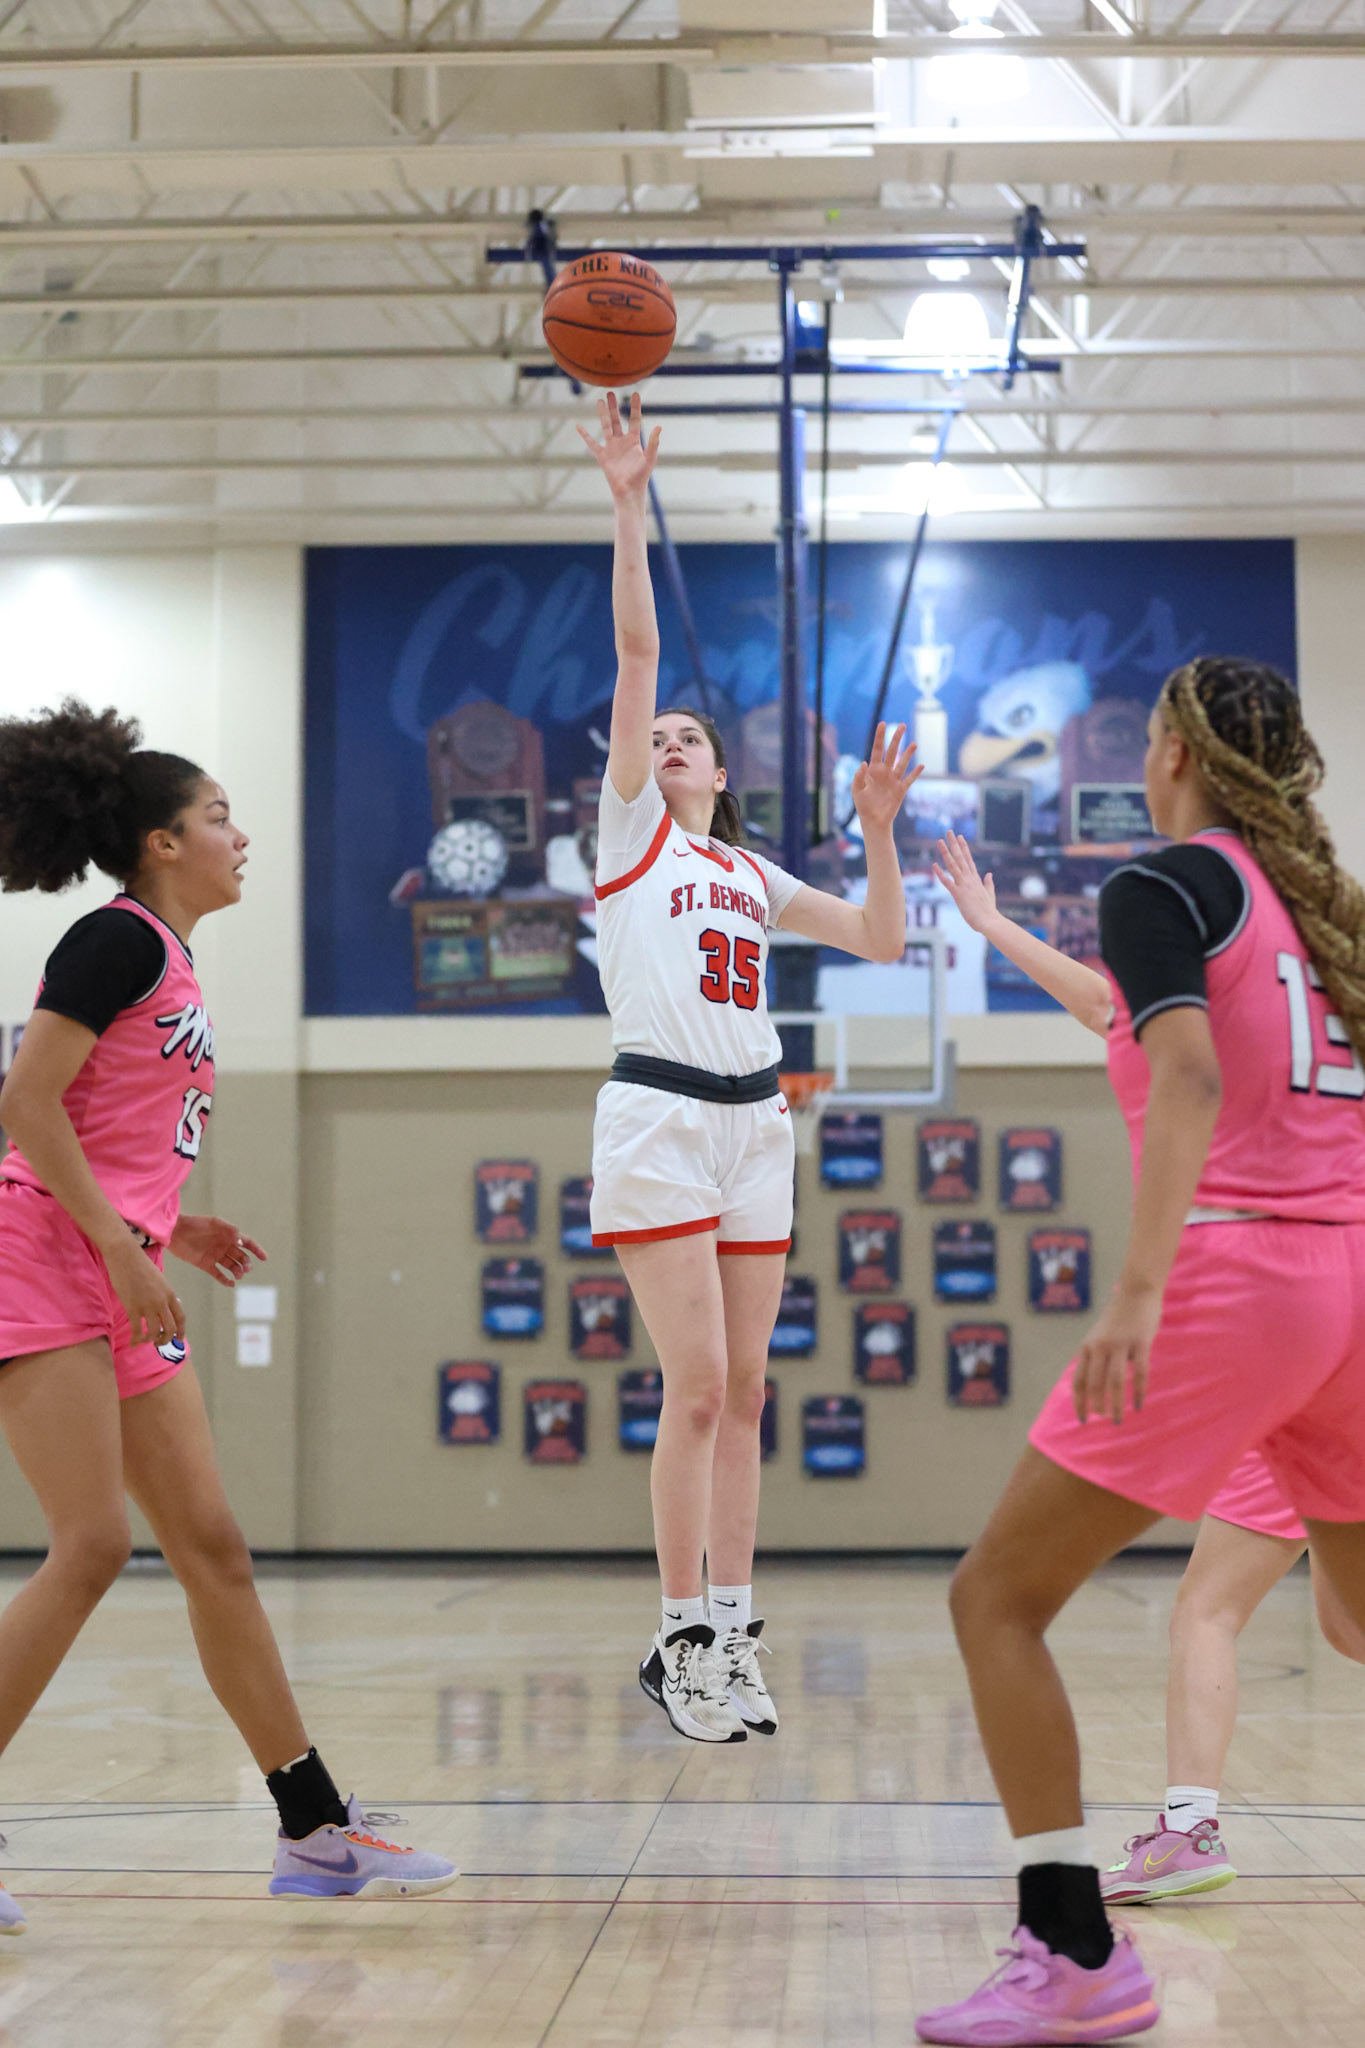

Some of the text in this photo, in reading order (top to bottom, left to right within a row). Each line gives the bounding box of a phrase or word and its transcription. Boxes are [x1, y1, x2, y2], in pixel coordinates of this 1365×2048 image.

[572, 256, 609, 276] THE
[670, 883, 703, 918] ST.
[699, 928, 760, 1011] 35
[173, 1086, 212, 1162] 15
